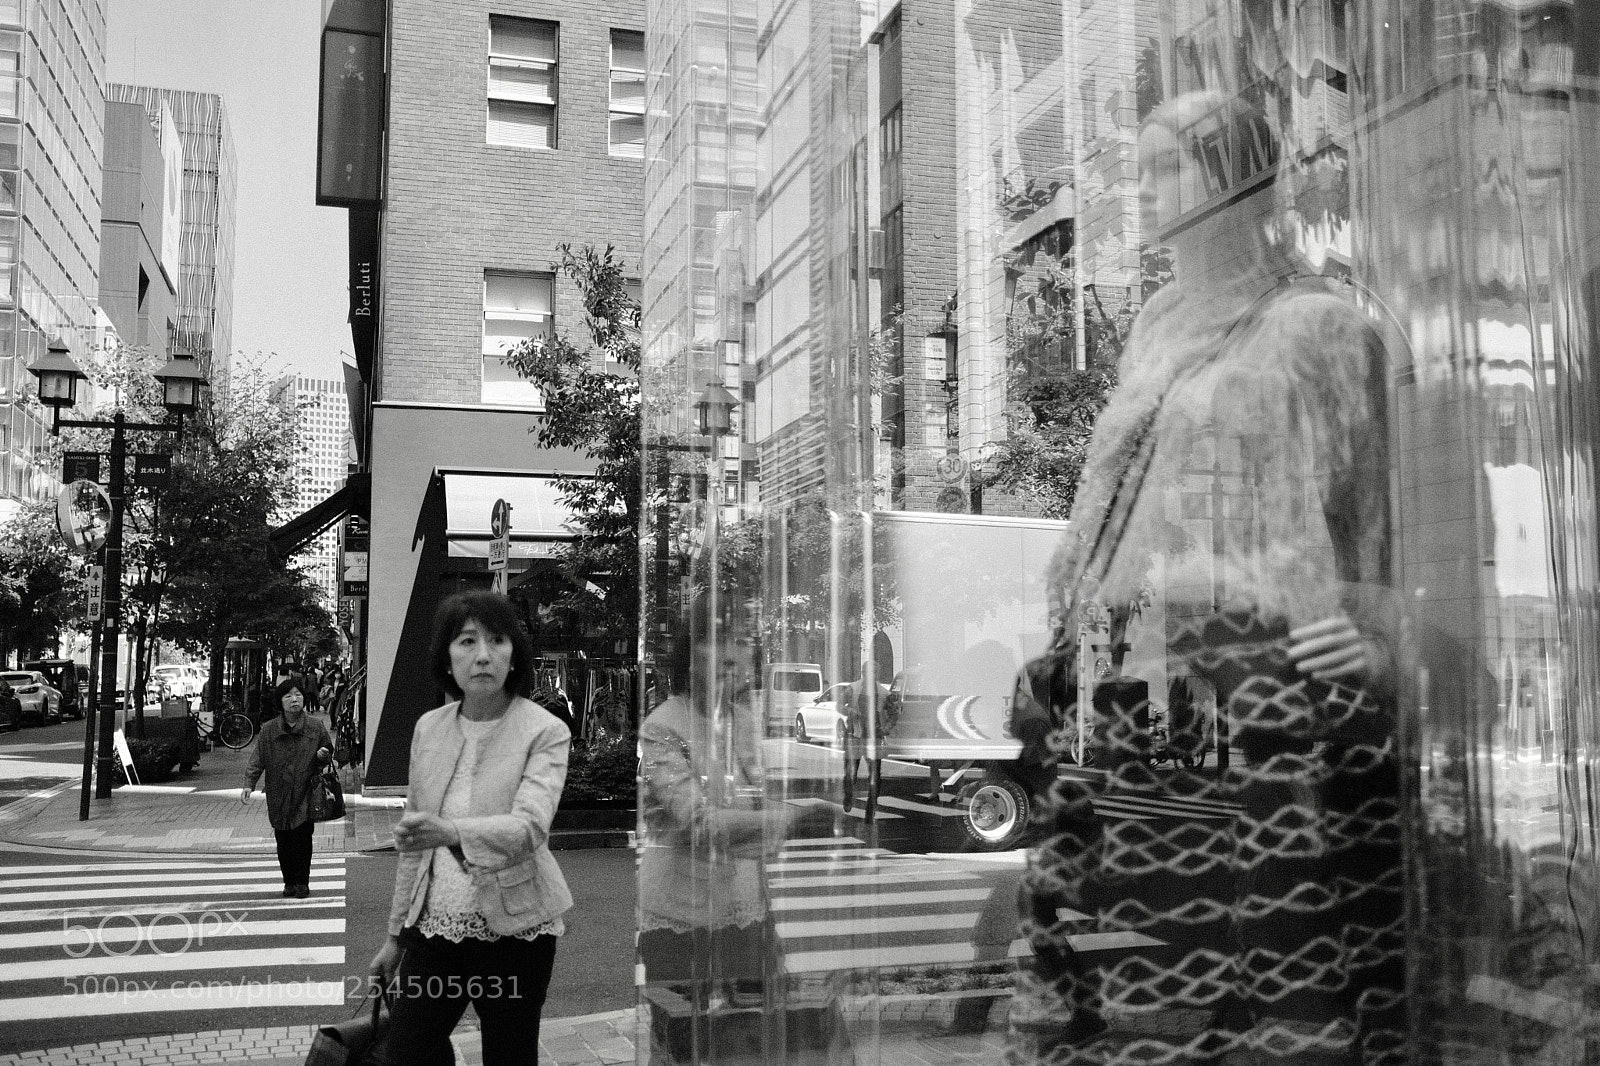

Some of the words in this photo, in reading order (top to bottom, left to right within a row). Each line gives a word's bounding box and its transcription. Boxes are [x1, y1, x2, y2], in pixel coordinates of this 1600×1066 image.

[355, 262, 371, 316] Berluti
[944, 458, 961, 474] 30
[89, 584, 100, 616] 注意
